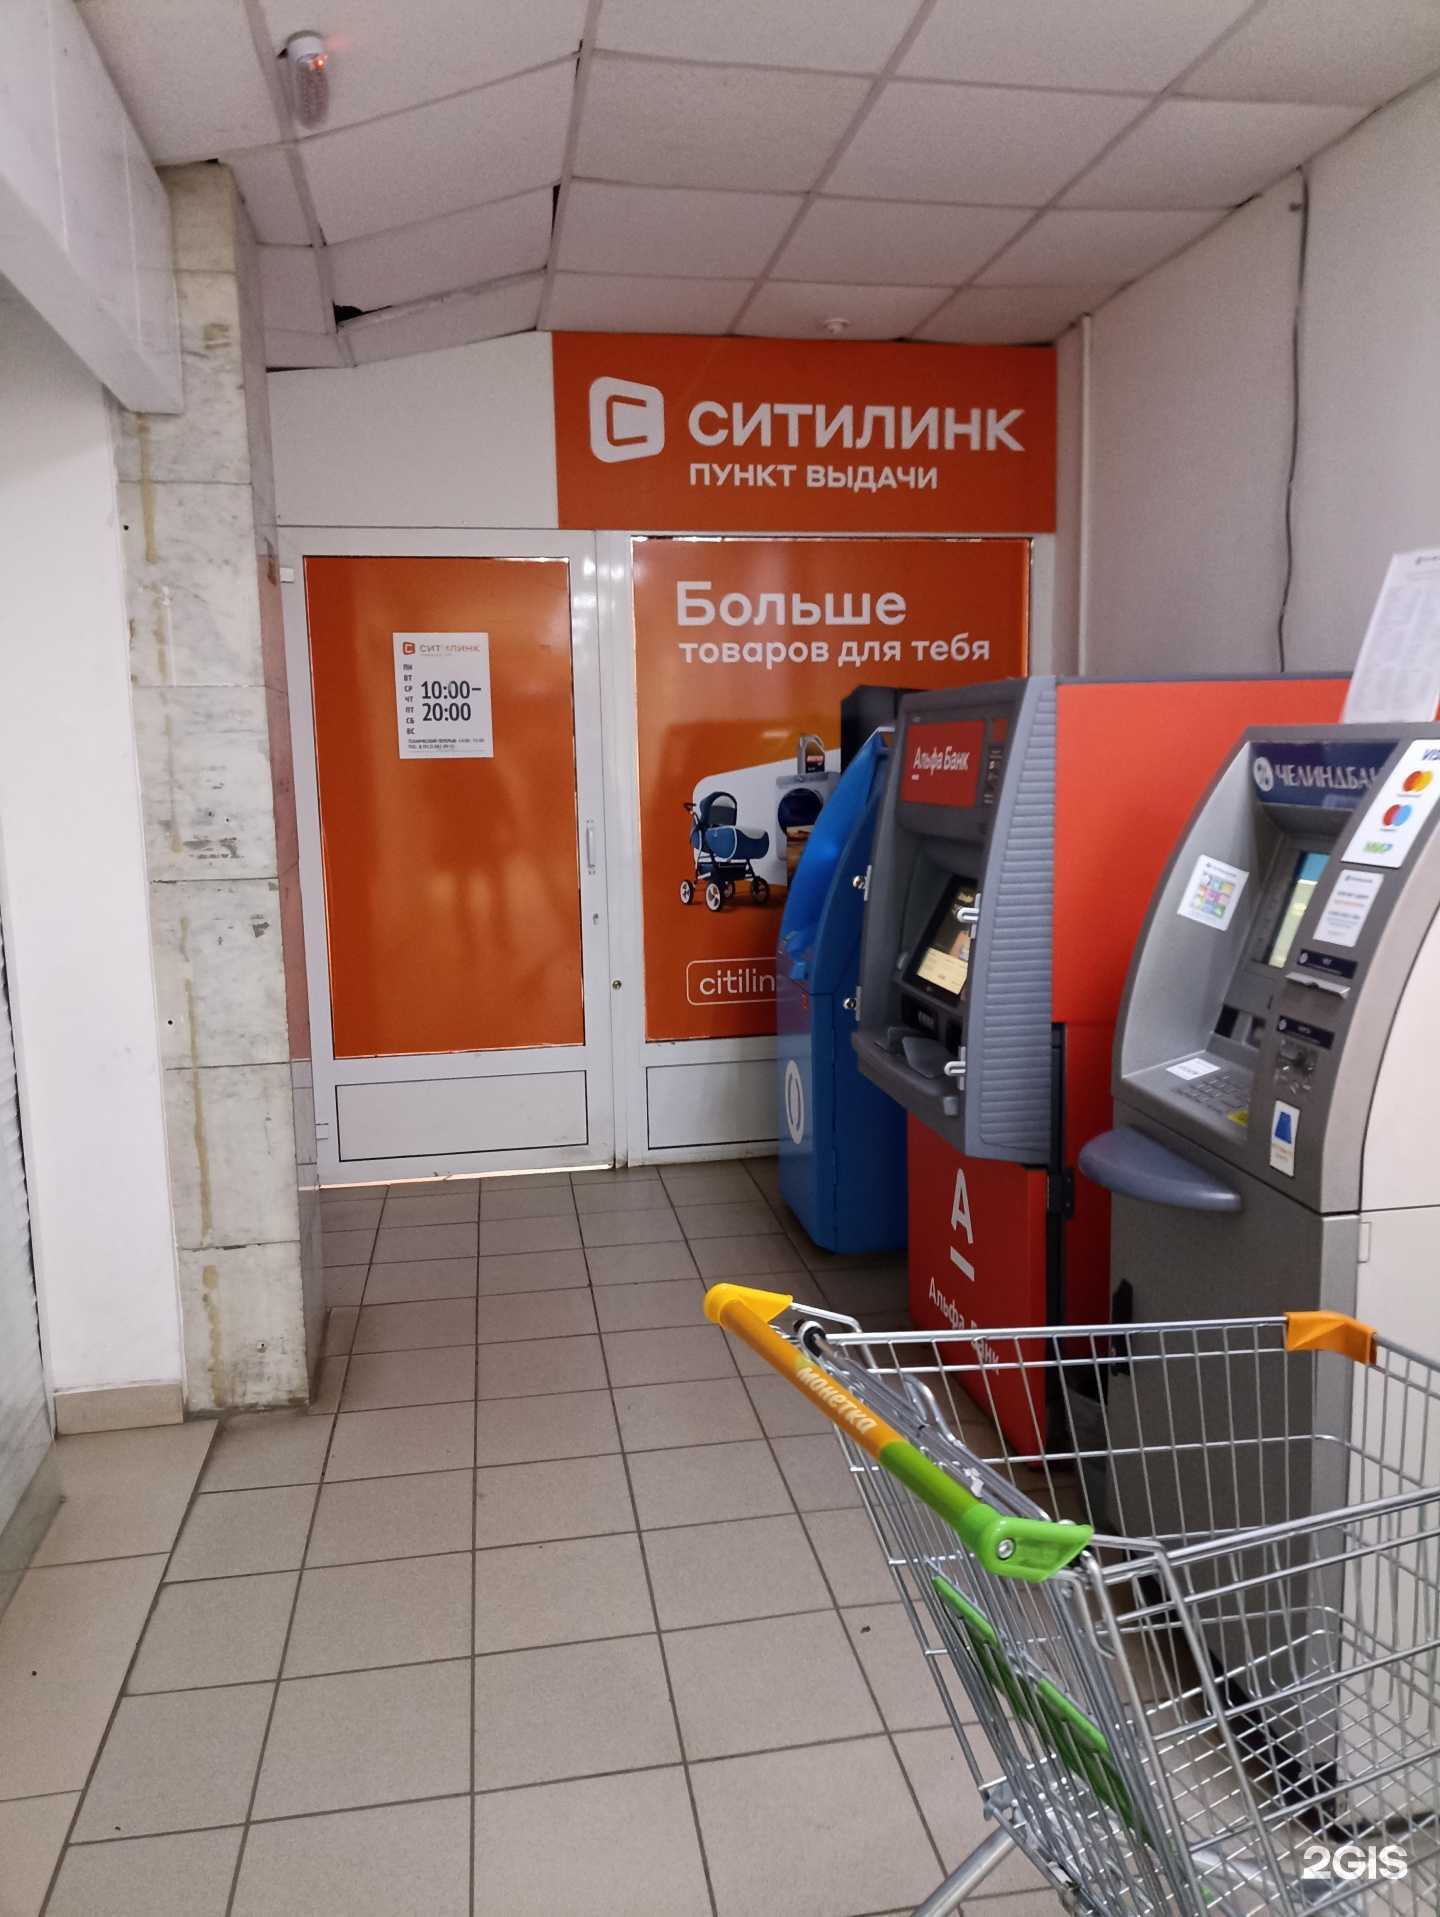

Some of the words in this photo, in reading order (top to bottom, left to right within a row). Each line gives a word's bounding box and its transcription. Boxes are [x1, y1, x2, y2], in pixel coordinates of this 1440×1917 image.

[688, 400, 1026, 452] СИТИЛИНК
[690, 463, 797, 488] ПУНКТ
[806, 464, 939, 491] ВЫДАЧИ
[676, 581, 907, 626] Больше
[419, 644, 481, 653] СИТЛИНК
[679, 641, 829, 669] товаров
[838, 640, 901, 667] для
[911, 633, 990, 661] тебя
[422, 702, 472, 721] 20:00
[1422, 749, 1440, 761] VIS
[699, 968, 780, 995] citilin
